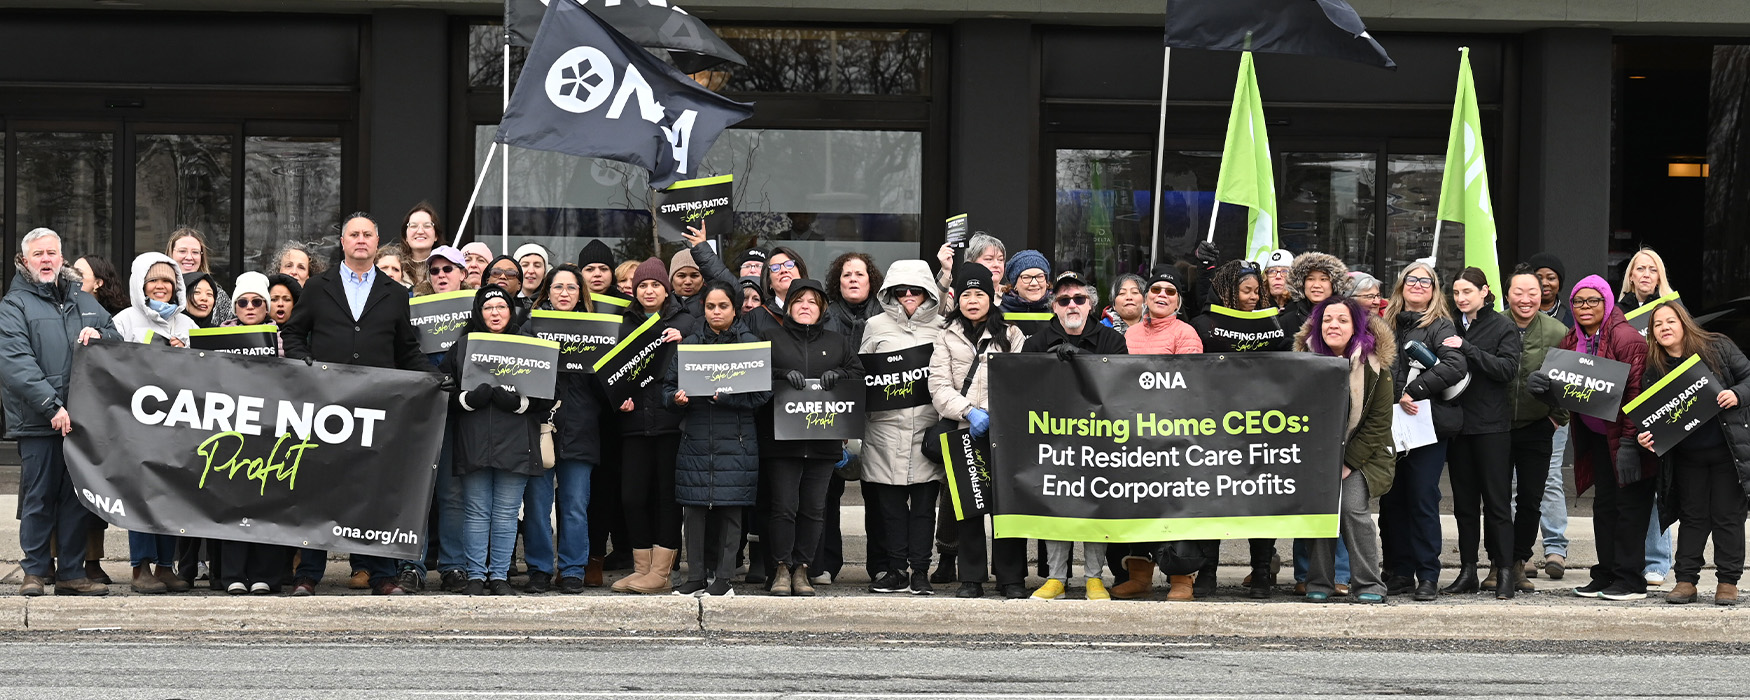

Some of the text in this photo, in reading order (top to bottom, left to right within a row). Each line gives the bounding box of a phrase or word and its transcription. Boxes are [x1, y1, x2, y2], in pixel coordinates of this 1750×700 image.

[661, 197, 728, 213] STAFFING RATIOS
[451, 311, 472, 320] RATI
[537, 332, 616, 345] STAFFING RATIOS
[1214, 328, 1284, 340] STAFFING RATIOS
[471, 354, 551, 370] STAFFING RATIOS
[608, 355, 640, 386] STAFFING
[685, 360, 764, 371] STAFFING RATIOS
[865, 367, 930, 386] CARE NOT
[1139, 371, 1187, 389] ONA
[1549, 368, 1614, 394] CARE NOT
[883, 380, 915, 400] Profit
[1563, 383, 1596, 402] Profit
[785, 401, 855, 413] CARE NOT
[1642, 376, 1709, 428] STAFFING RATIOS
[130, 385, 386, 448] CARE NOT
[805, 411, 838, 429] Profit
[1028, 409, 1310, 443] Nursing Home CEOs:
[196, 430, 319, 496] Profit
[1038, 442, 1302, 468] Put Resident Care First
[962, 433, 984, 509] STAFFING RATIOS
[1042, 474, 1296, 503] End Corporate Profits
[332, 524, 418, 545] ona.org/nh
